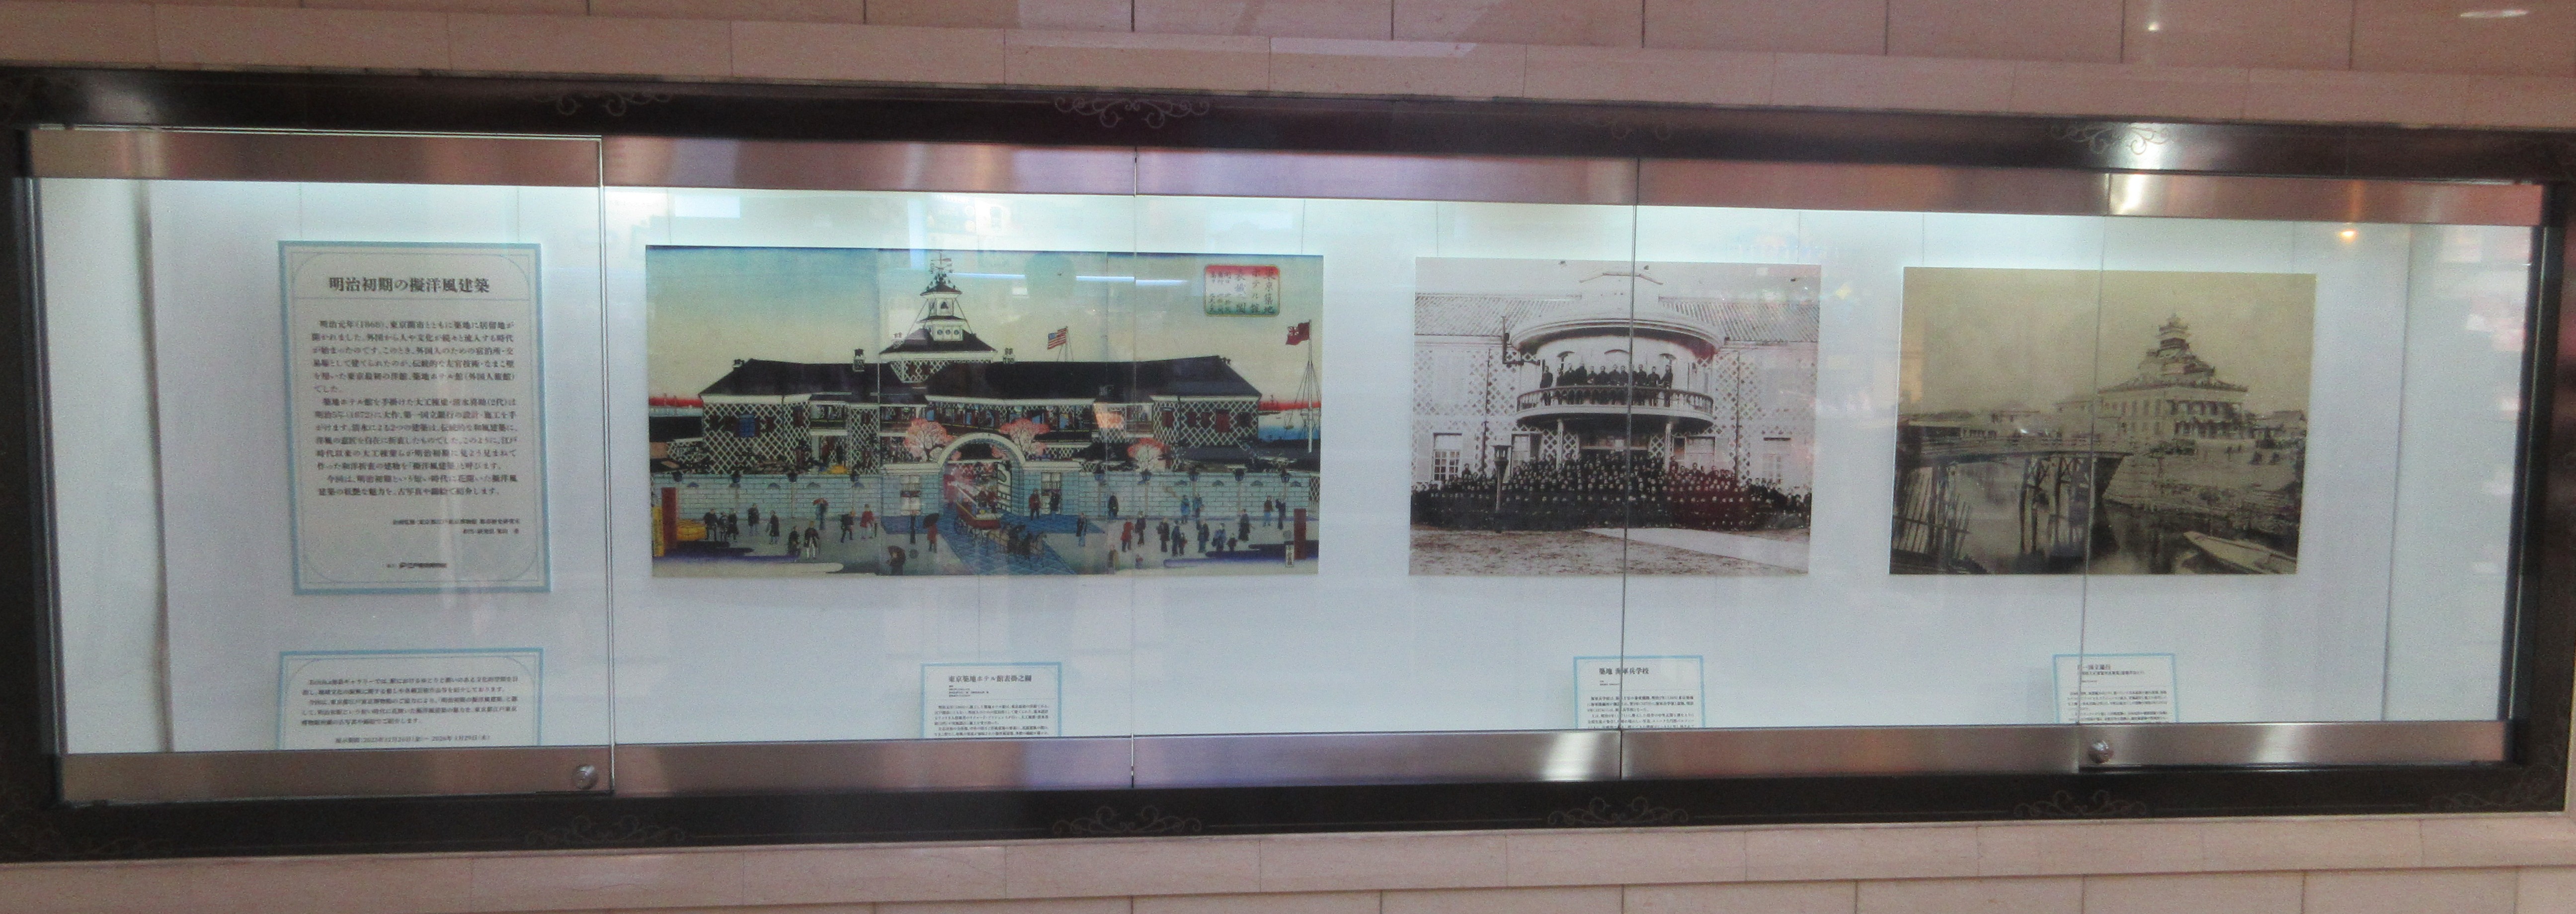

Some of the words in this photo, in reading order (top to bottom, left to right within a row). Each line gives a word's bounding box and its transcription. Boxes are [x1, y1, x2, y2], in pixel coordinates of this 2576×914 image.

[328, 276, 490, 293] 明治初期の擬洋風建築
